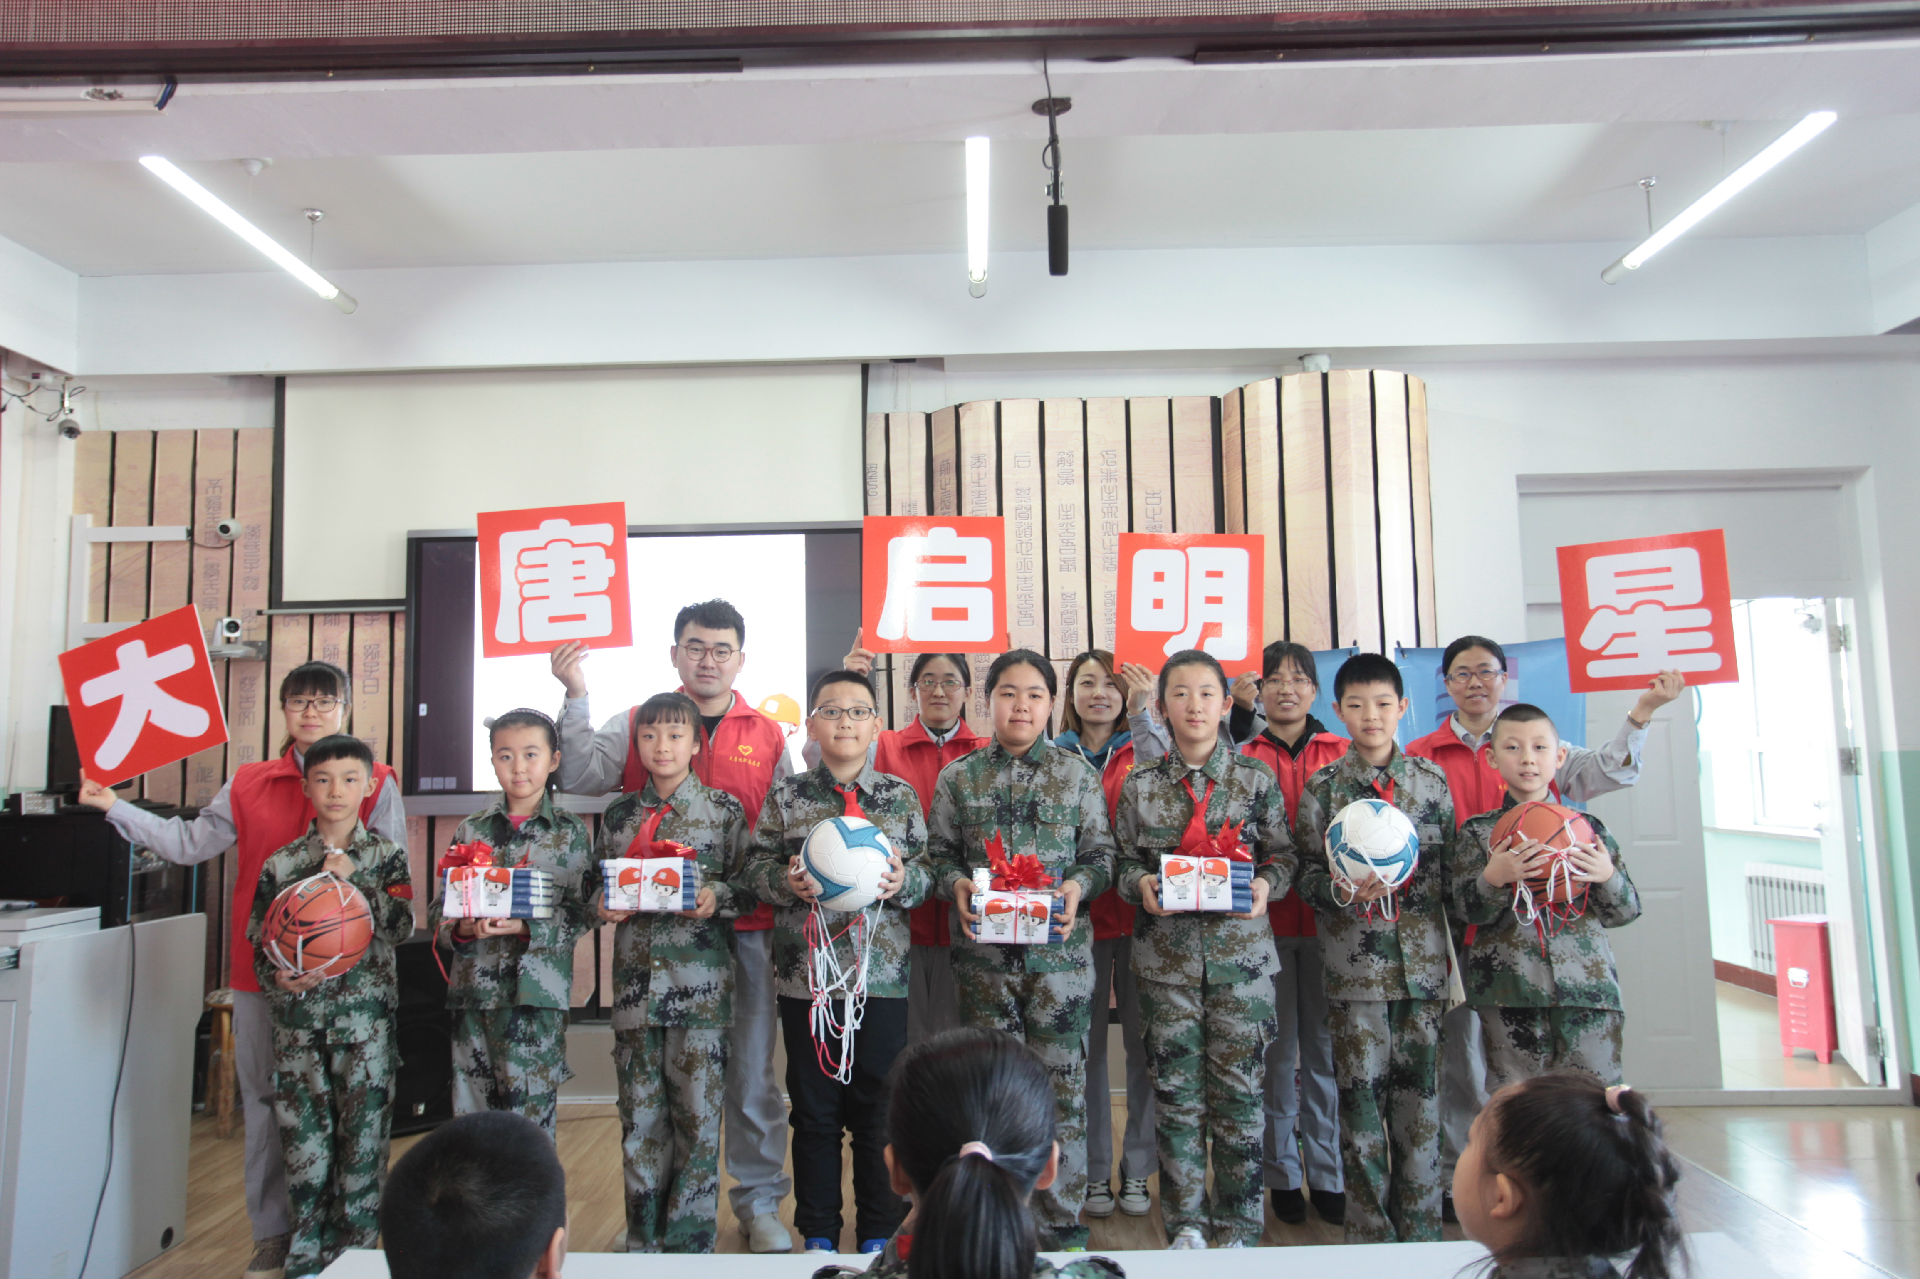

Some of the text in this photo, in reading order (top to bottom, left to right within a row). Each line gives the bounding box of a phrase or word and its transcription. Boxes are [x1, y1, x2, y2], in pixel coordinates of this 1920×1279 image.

[495, 519, 615, 643] 唐
[876, 526, 994, 641] 启
[1131, 547, 1250, 661] 明
[1580, 547, 1722, 678] 星
[81, 640, 209, 769] 大
